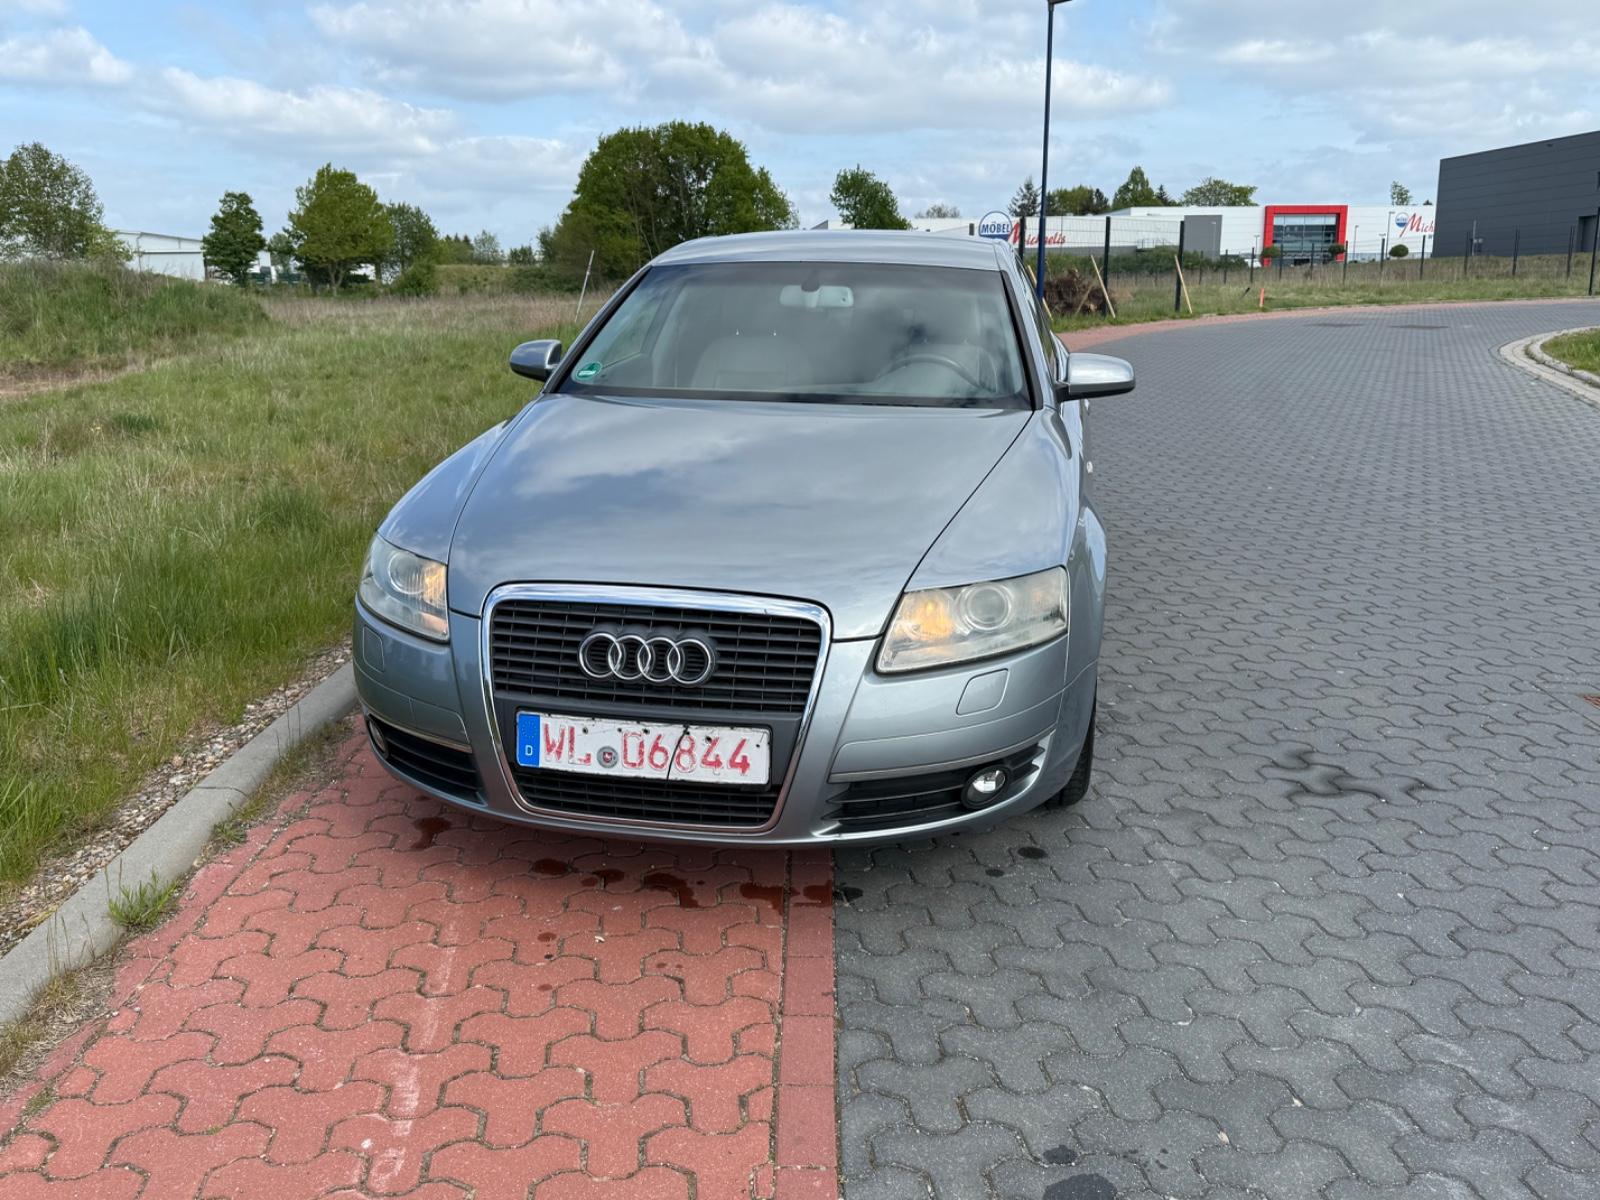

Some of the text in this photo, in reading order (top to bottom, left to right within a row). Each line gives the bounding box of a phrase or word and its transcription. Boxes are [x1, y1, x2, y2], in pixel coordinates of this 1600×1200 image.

[981, 222, 1010, 233] MÖBEL
[543, 722, 592, 766] WL
[525, 745, 533, 756] D
